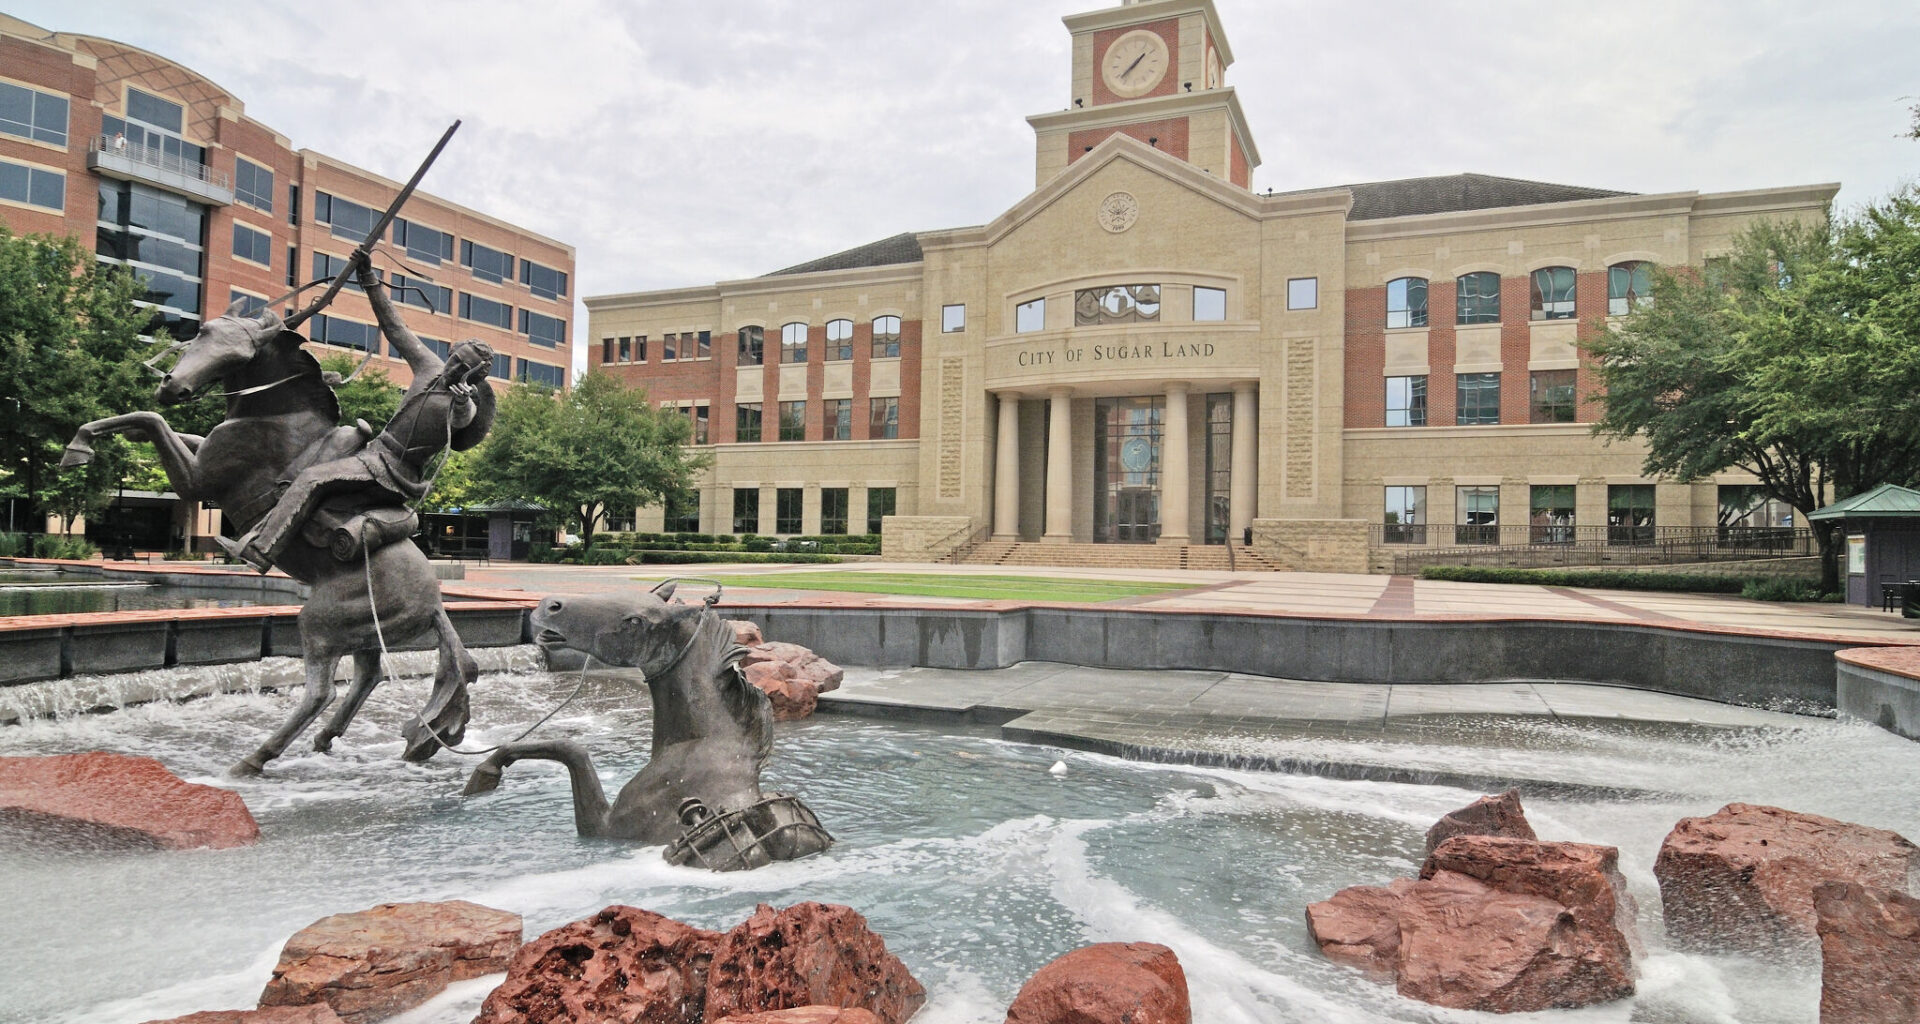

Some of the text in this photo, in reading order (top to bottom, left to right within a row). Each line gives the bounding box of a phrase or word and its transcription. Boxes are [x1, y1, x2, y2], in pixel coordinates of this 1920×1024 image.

[1018, 342, 1214, 366] CITY OF SUGAR LAND
